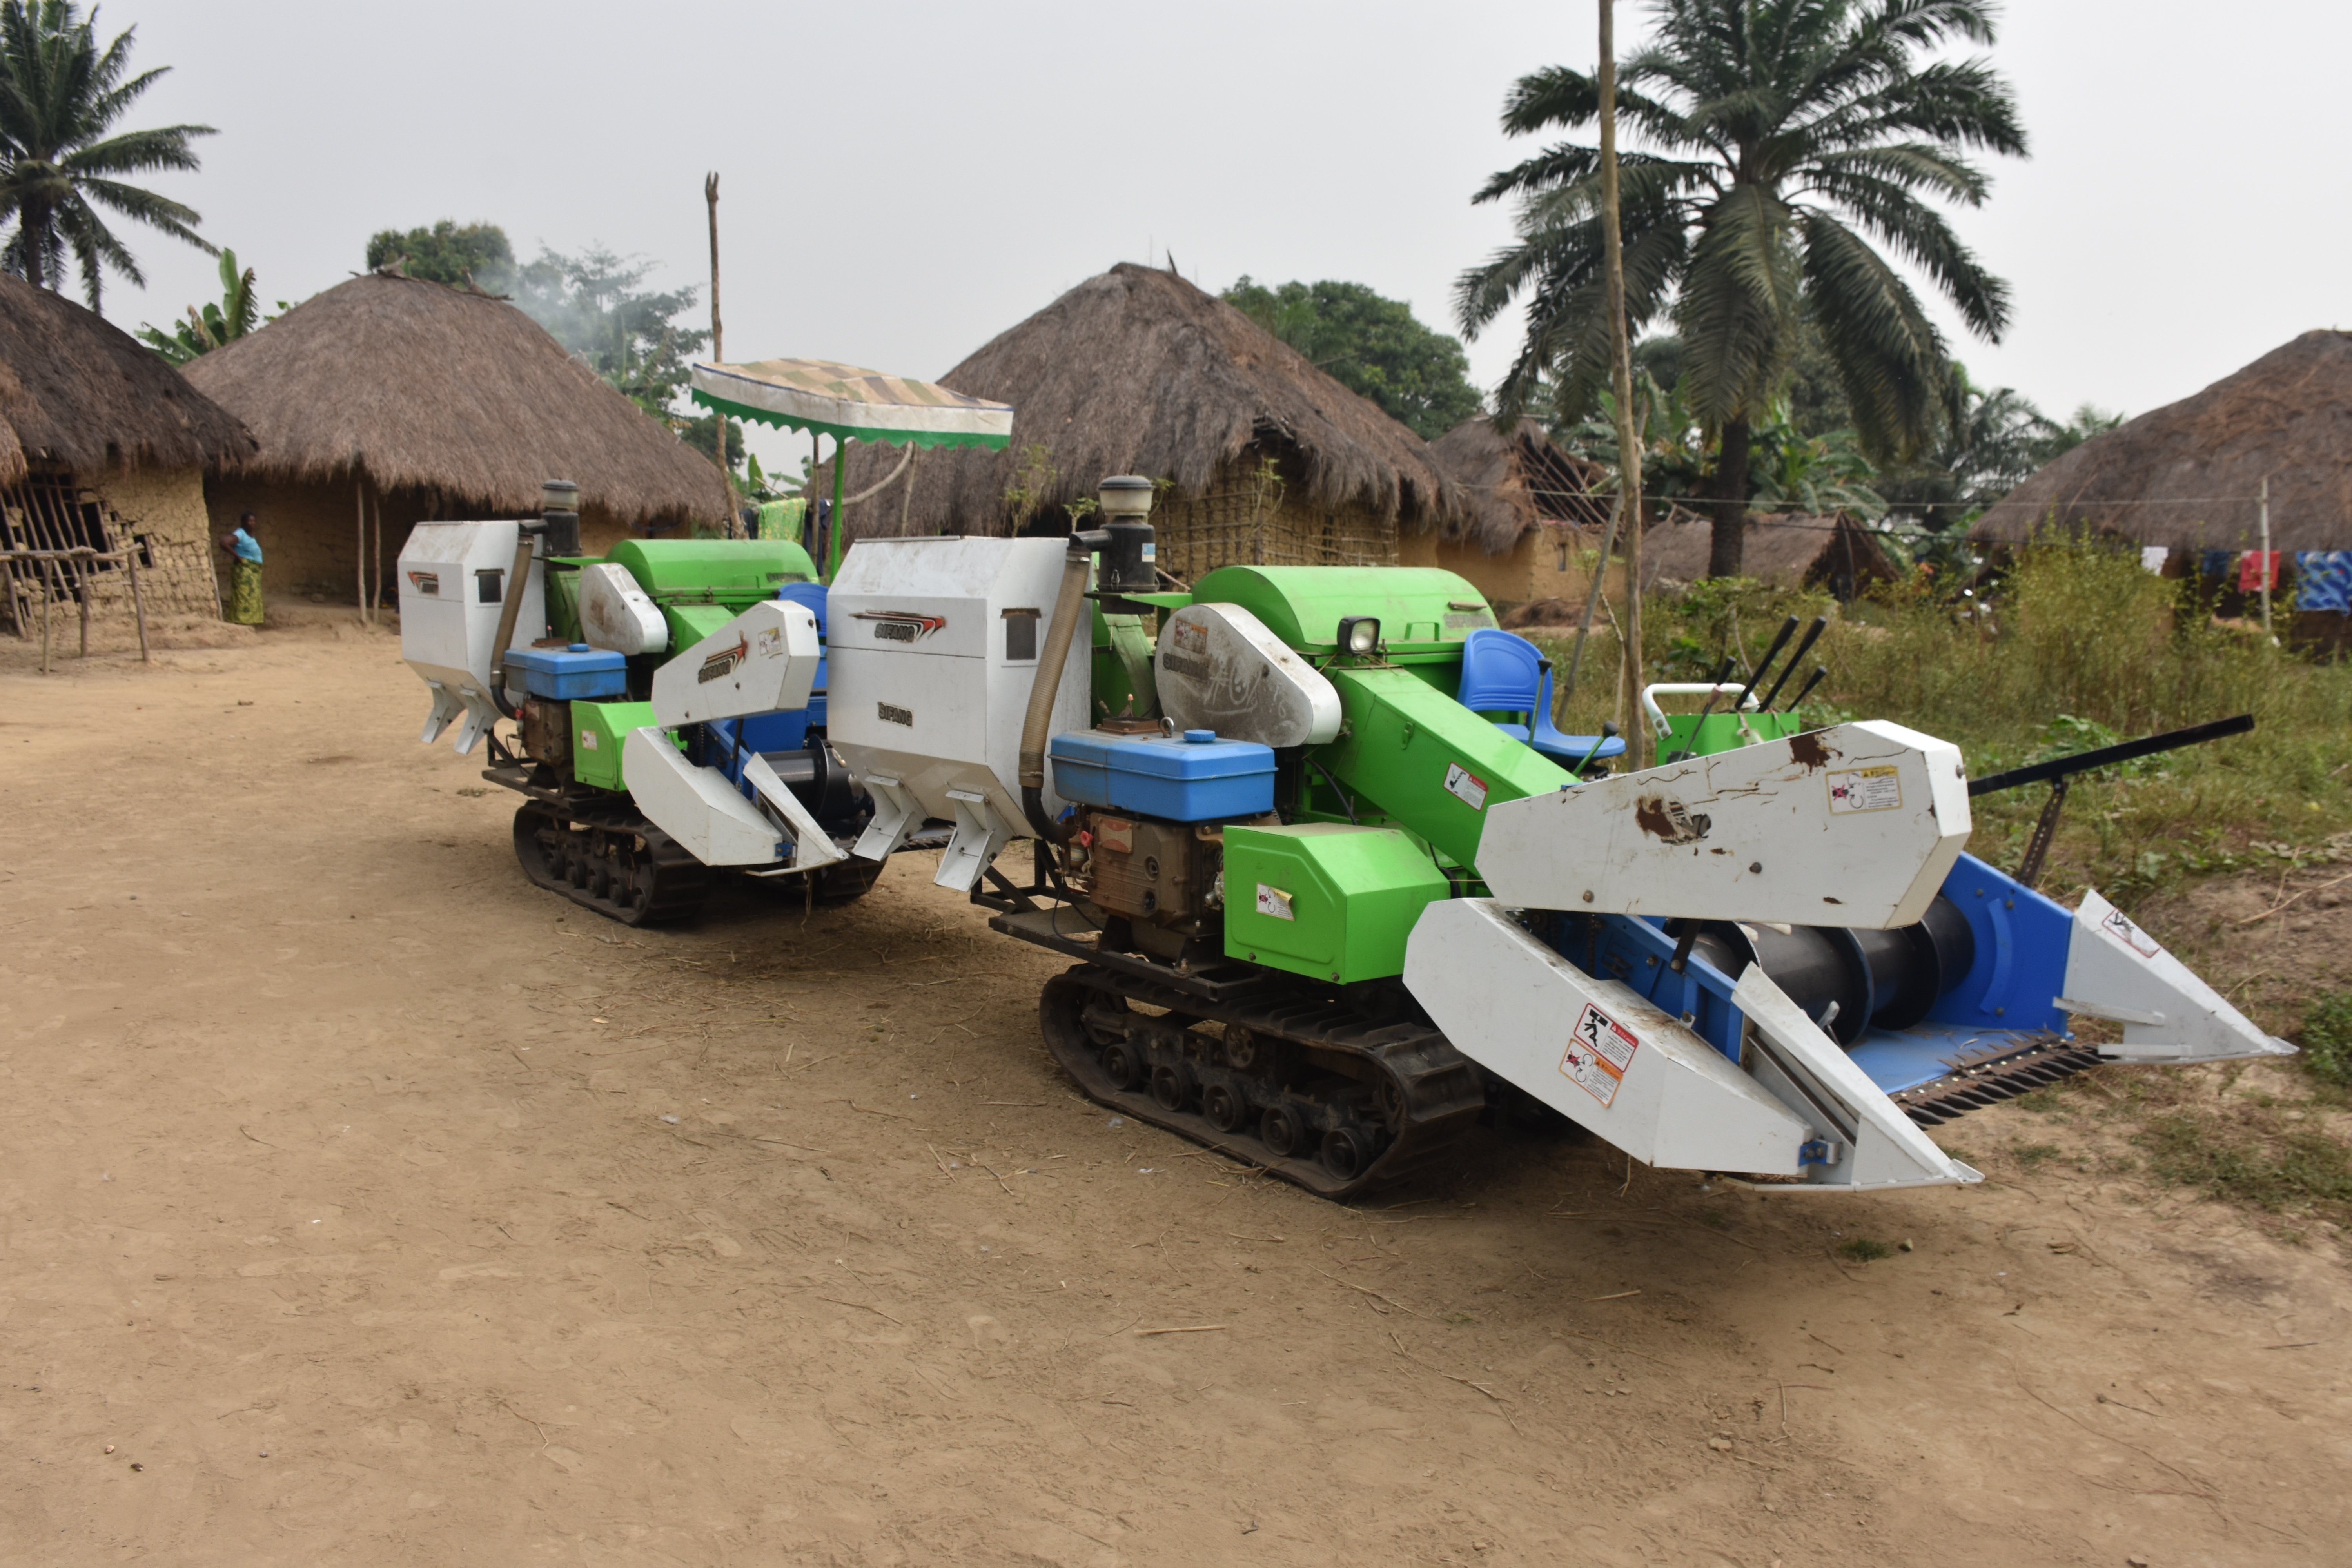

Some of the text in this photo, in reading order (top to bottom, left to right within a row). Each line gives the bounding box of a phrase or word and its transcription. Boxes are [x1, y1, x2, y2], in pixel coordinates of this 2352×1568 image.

[874, 623, 915, 641] SIFANG
[698, 660, 731, 684] SIFANG
[1163, 653, 1208, 681] SIFANG
[878, 704, 912, 726] SIFANG
